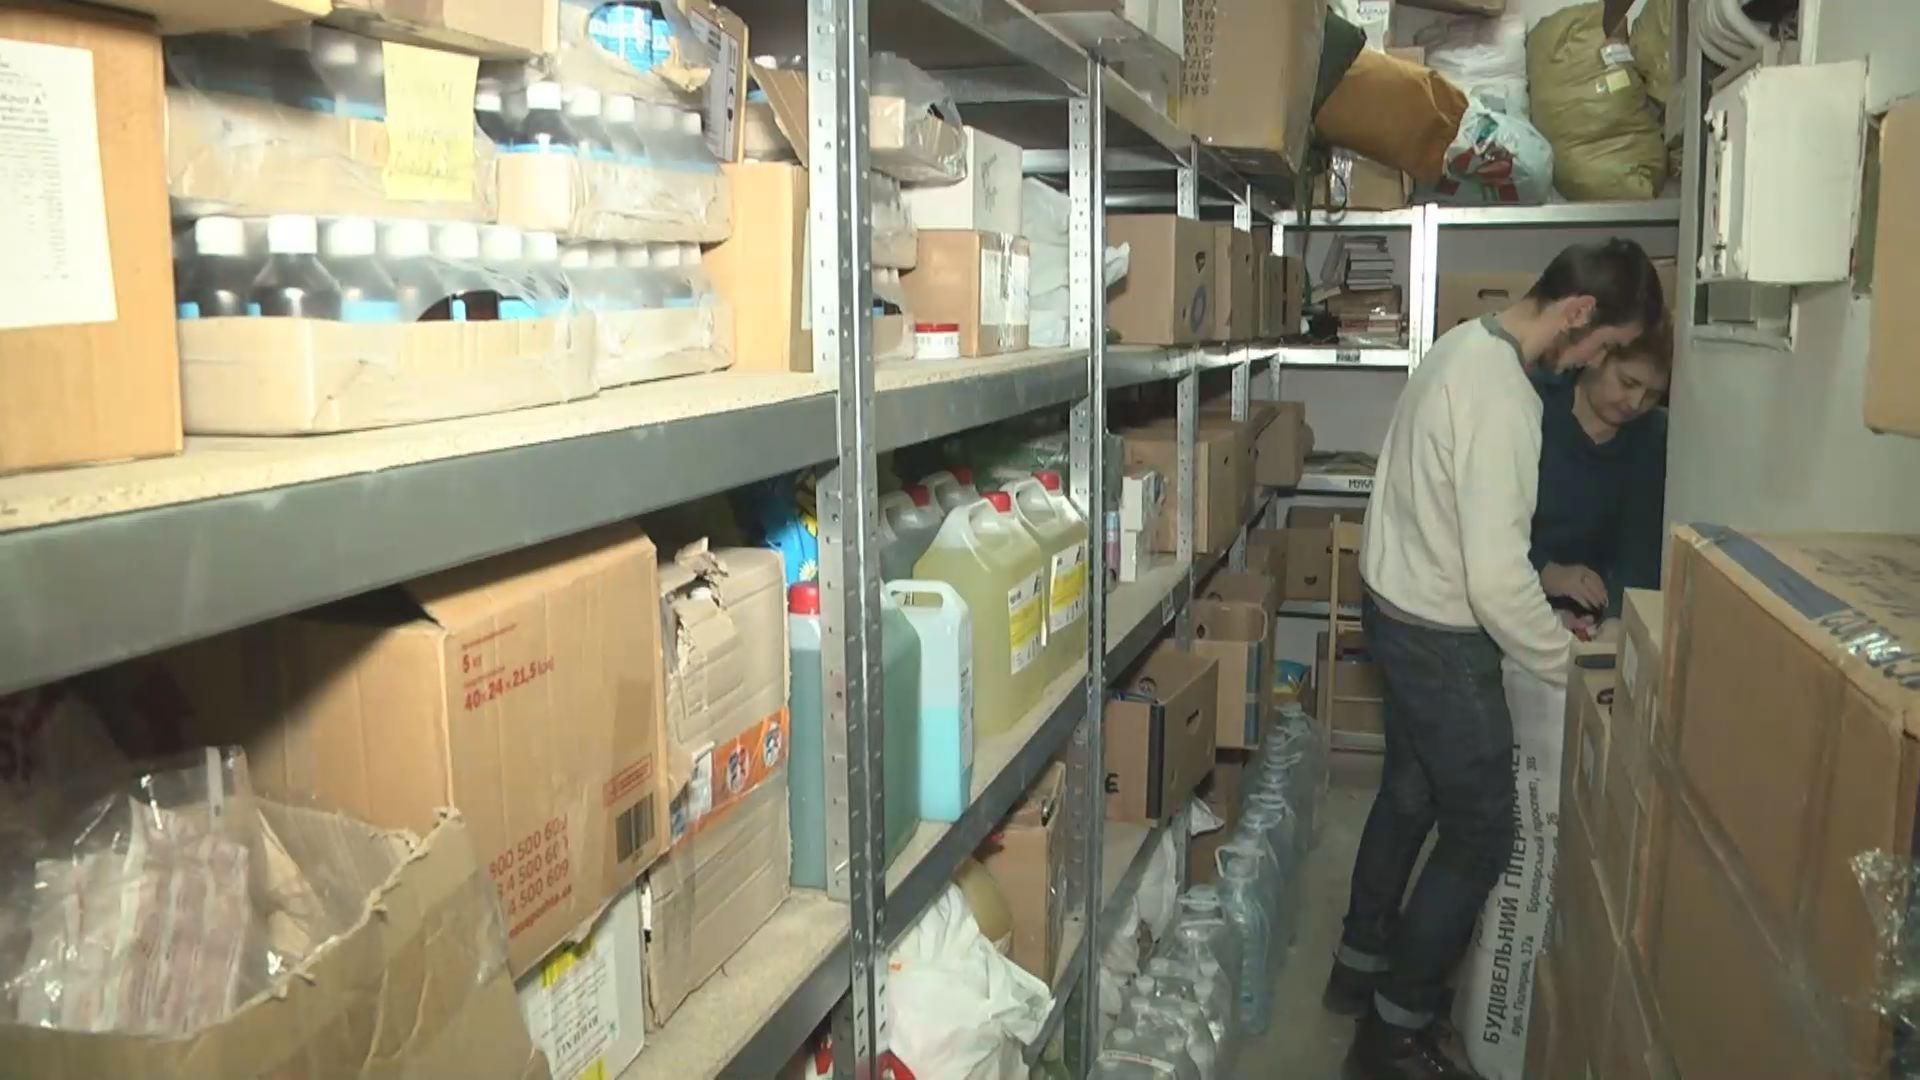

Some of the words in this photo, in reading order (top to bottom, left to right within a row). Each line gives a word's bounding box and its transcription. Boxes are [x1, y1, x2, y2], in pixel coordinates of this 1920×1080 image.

[517, 830, 542, 862] 500
[518, 853, 543, 885] 500
[520, 877, 543, 908] 500
[1483, 896, 1519, 1045] БУДІВЕЛЬНИЙ
